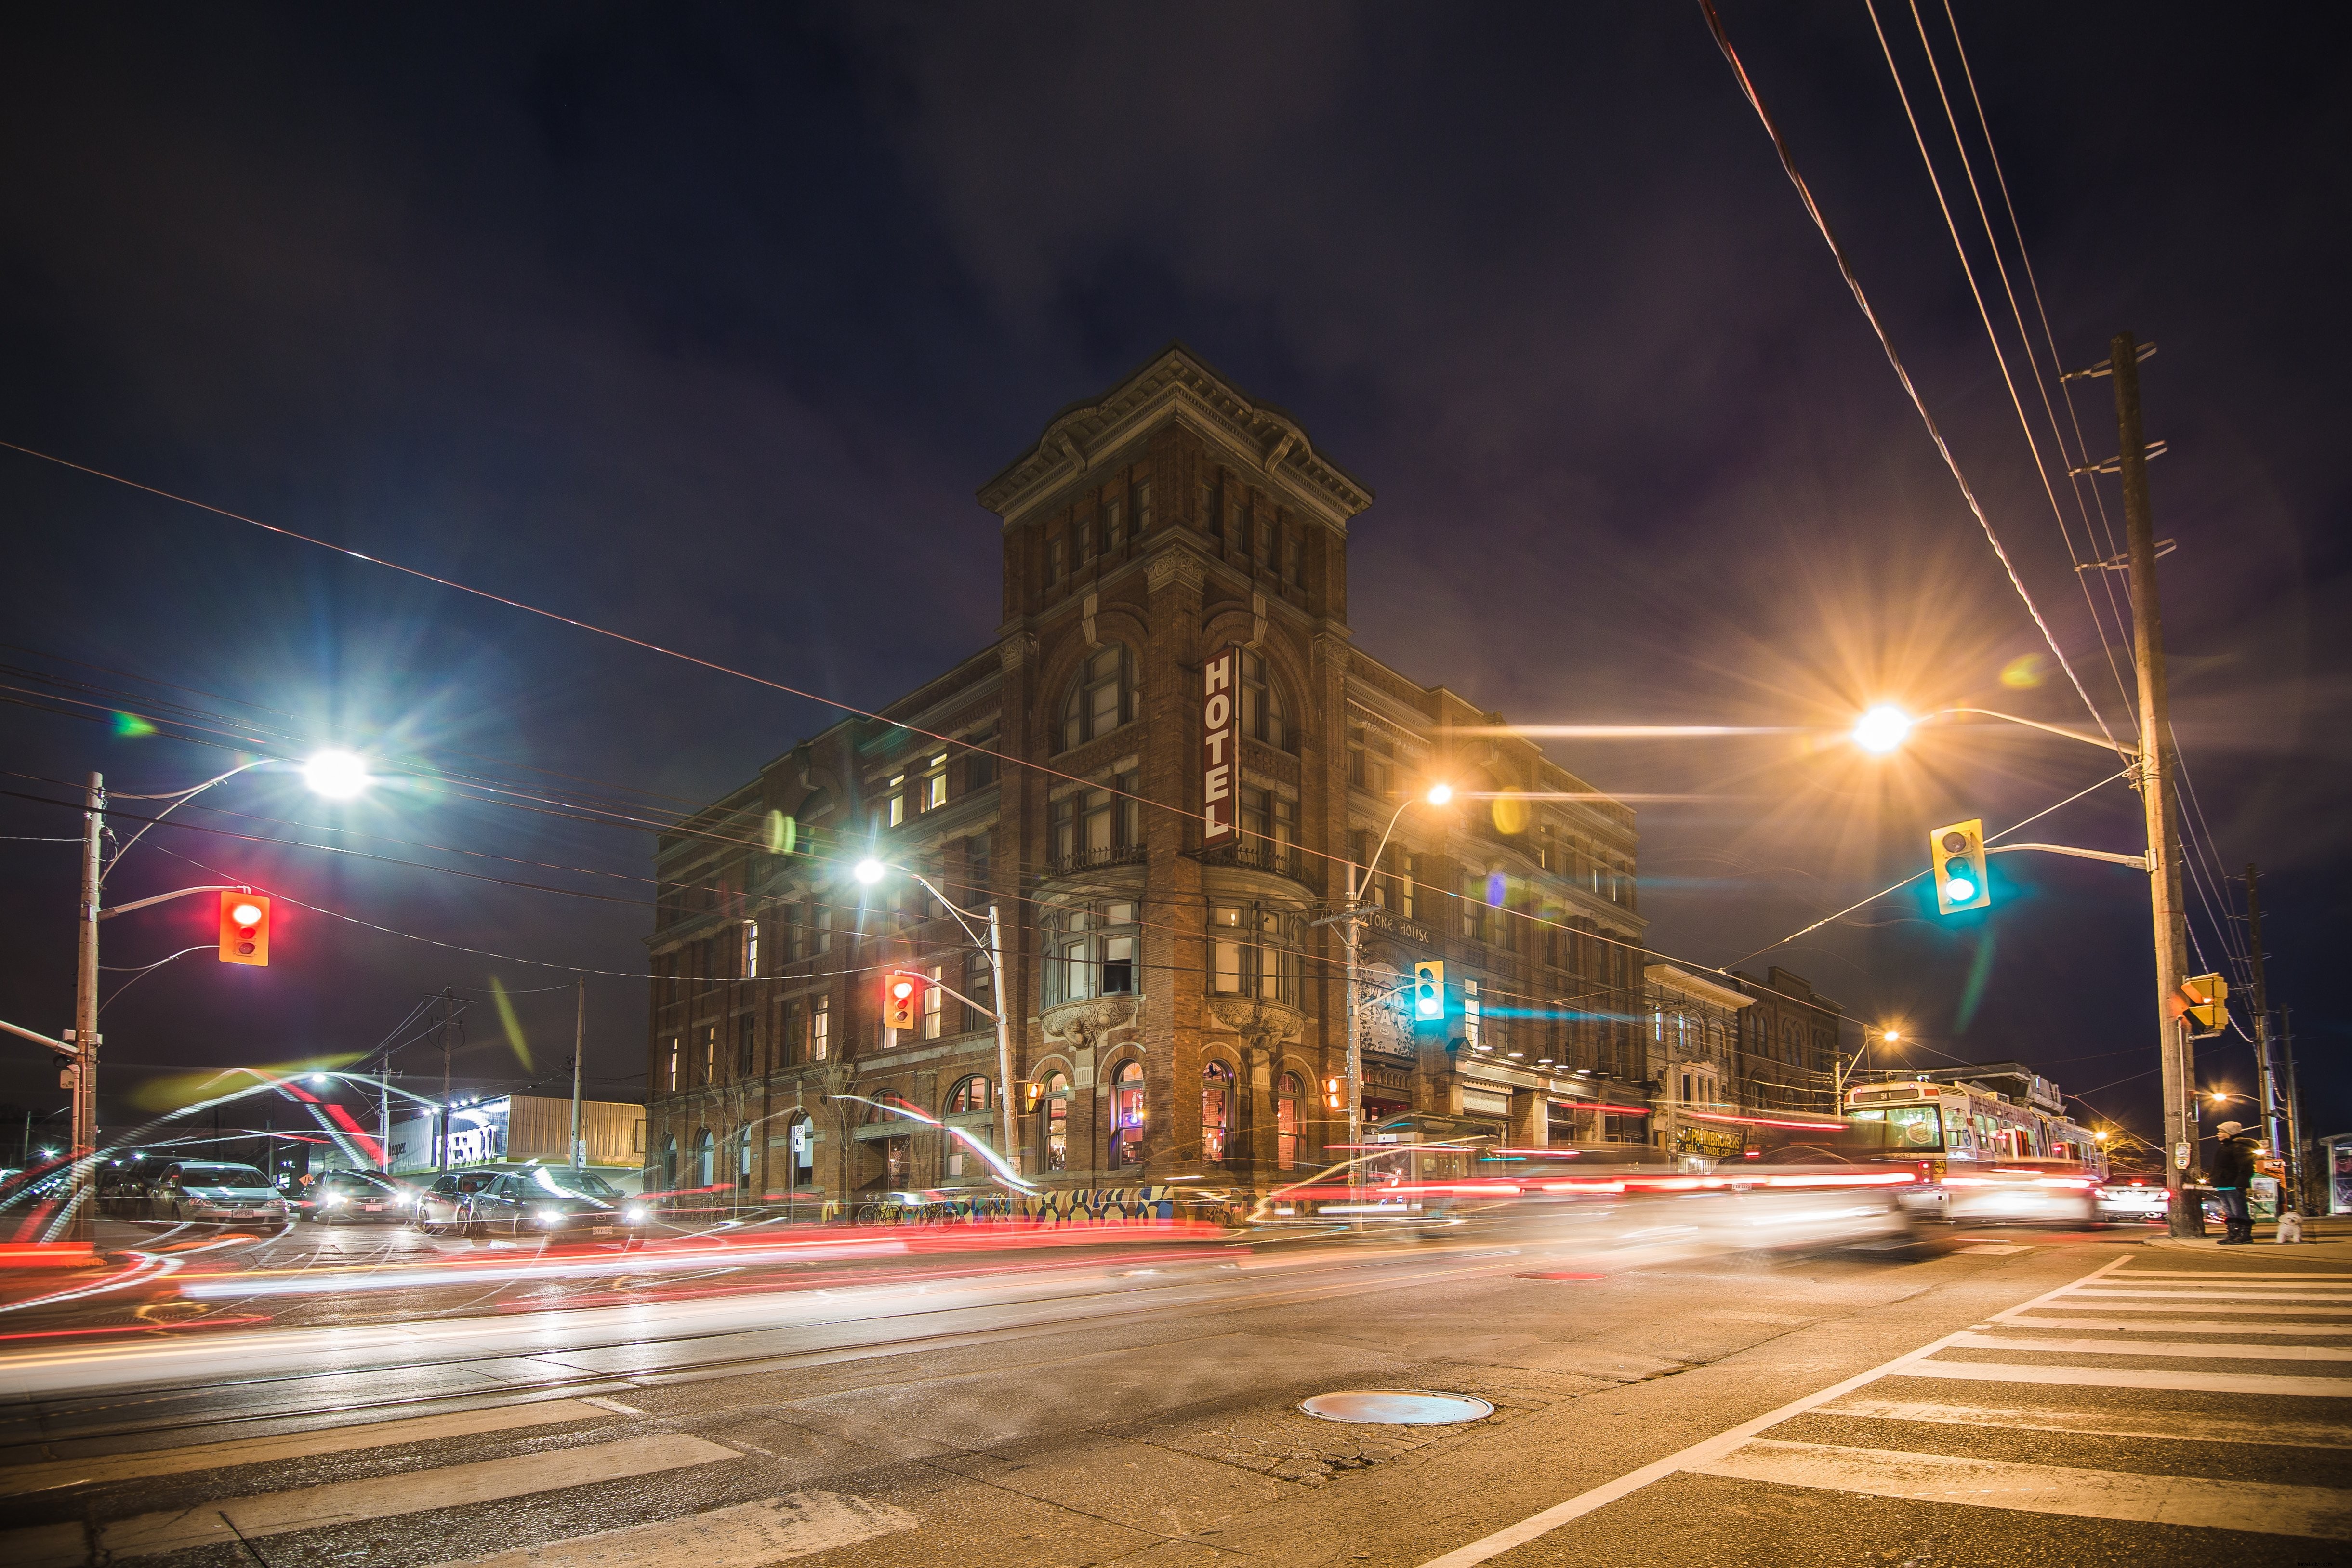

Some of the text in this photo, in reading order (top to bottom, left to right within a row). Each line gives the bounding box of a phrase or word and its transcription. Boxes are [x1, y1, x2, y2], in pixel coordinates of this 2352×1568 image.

[1205, 655, 1229, 839] HOTEL
[1400, 922, 1430, 943] HOUSE
[388, 1142, 406, 1159] heaper.
[1685, 1144, 1698, 1153] SELL
[1703, 1146, 1720, 1156] TRADE
